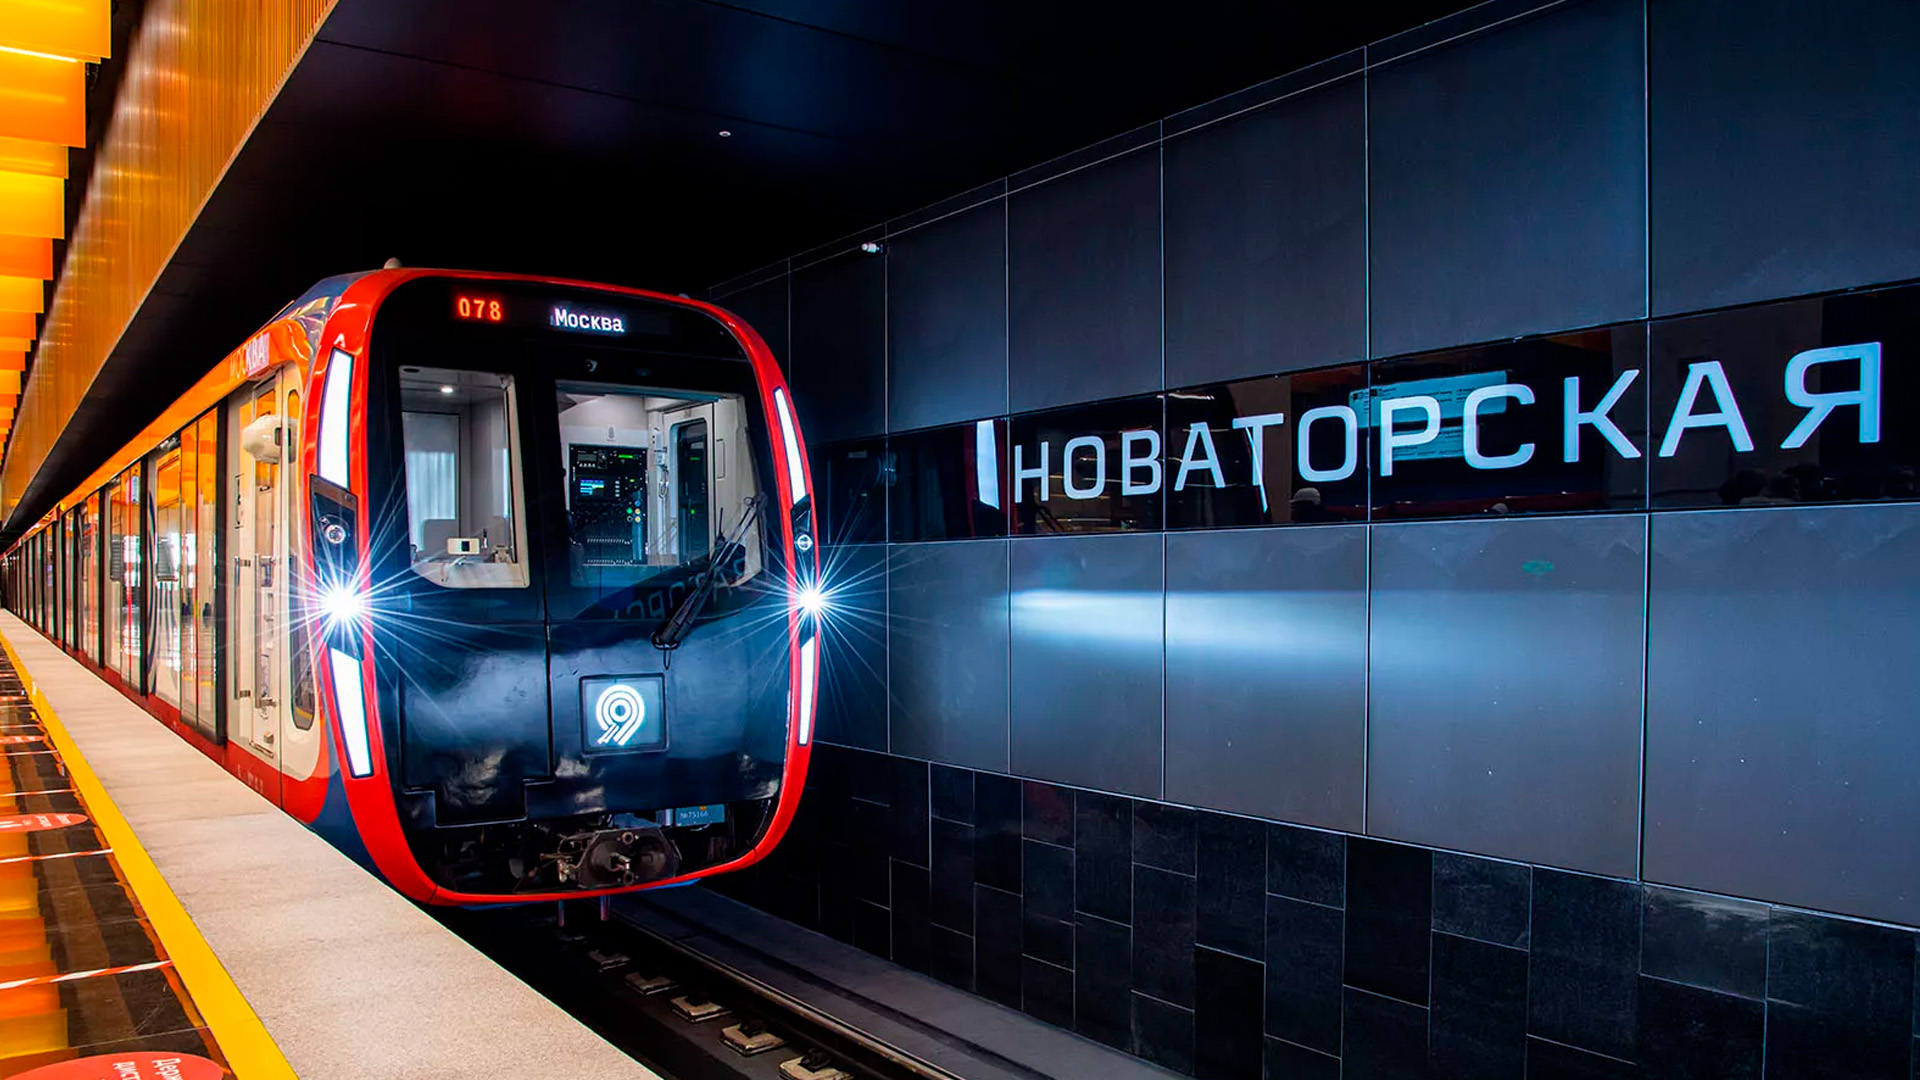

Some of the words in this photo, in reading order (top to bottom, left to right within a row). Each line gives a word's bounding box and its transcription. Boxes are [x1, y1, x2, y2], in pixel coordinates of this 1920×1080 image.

[457, 297, 501, 321] 078
[554, 307, 625, 333] Москва
[1014, 341, 1882, 503] НОВАТОРСКАЯ
